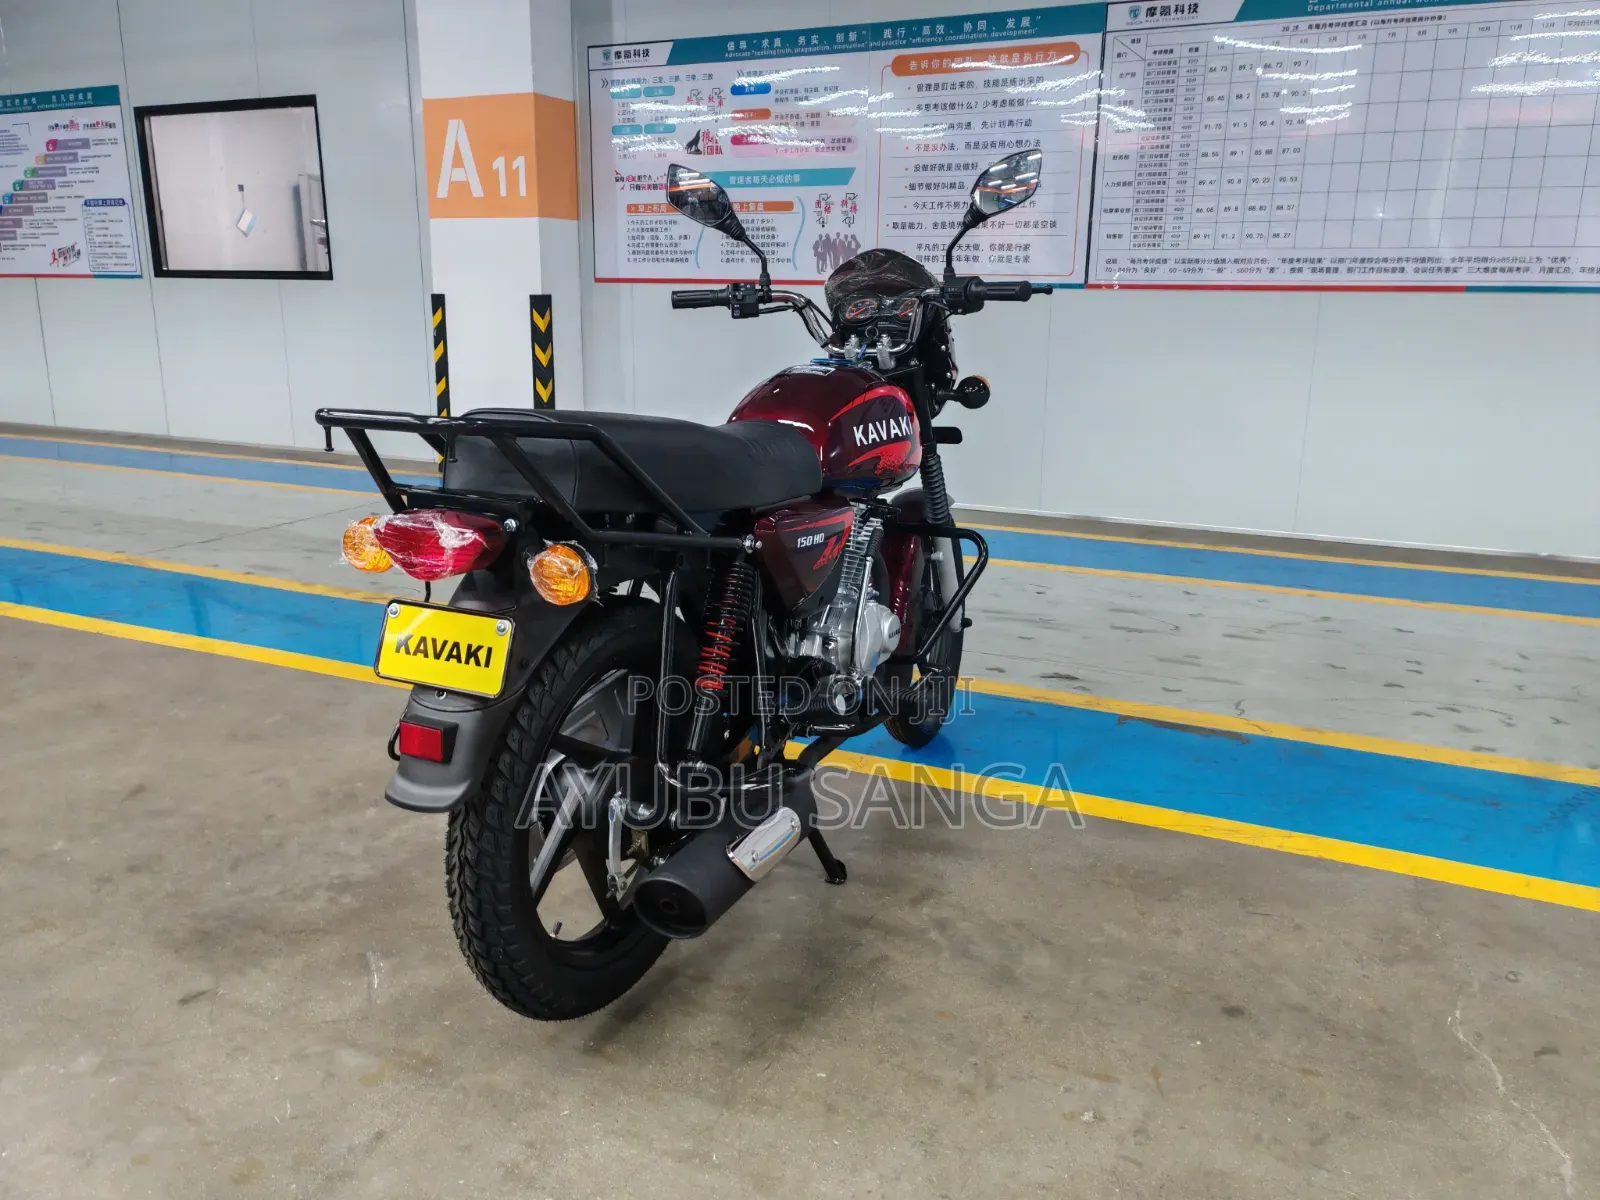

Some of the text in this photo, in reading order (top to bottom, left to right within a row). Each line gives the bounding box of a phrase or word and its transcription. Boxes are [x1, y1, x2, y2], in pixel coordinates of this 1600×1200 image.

[1307, 1, 1373, 12] Departmental
[881, 39, 907, 48] practice
[436, 119, 527, 198] A 11
[915, 243, 1031, 252] 平凡的工天天做，你就是行家
[853, 415, 913, 447] KAVAKI
[797, 536, 813, 548] 150
[395, 633, 493, 669] KAVAKI
